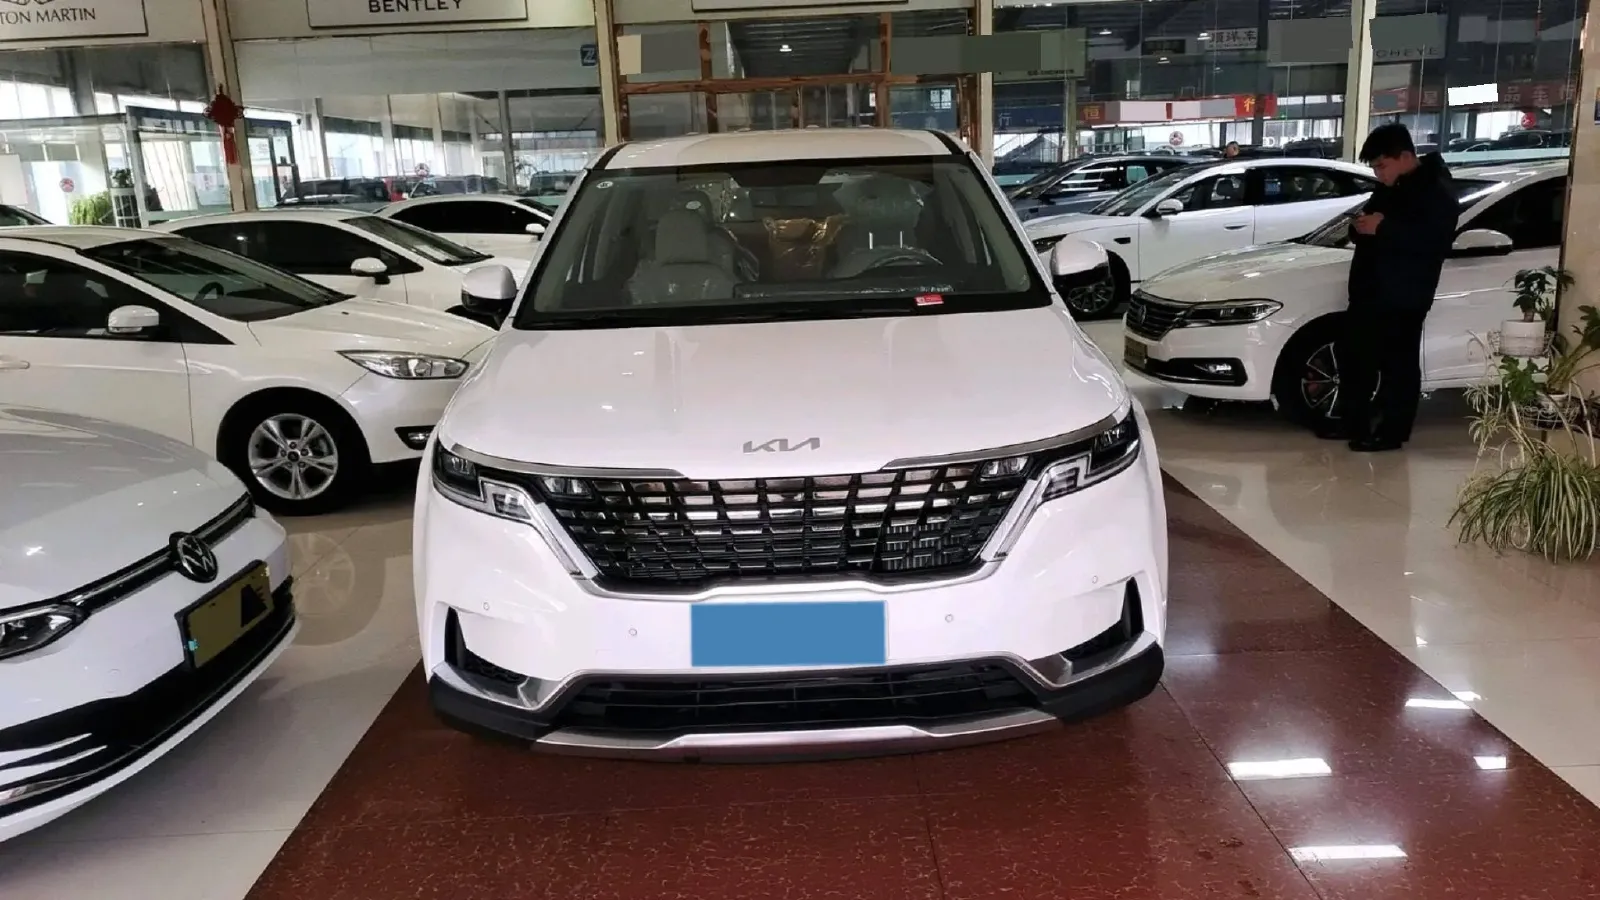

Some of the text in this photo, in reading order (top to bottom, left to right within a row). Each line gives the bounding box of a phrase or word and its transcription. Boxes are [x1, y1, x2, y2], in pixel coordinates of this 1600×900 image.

[368, 0, 460, 13] BENTLEY
[36, 8, 96, 23] MARTIN
[742, 437, 820, 454] KIA
